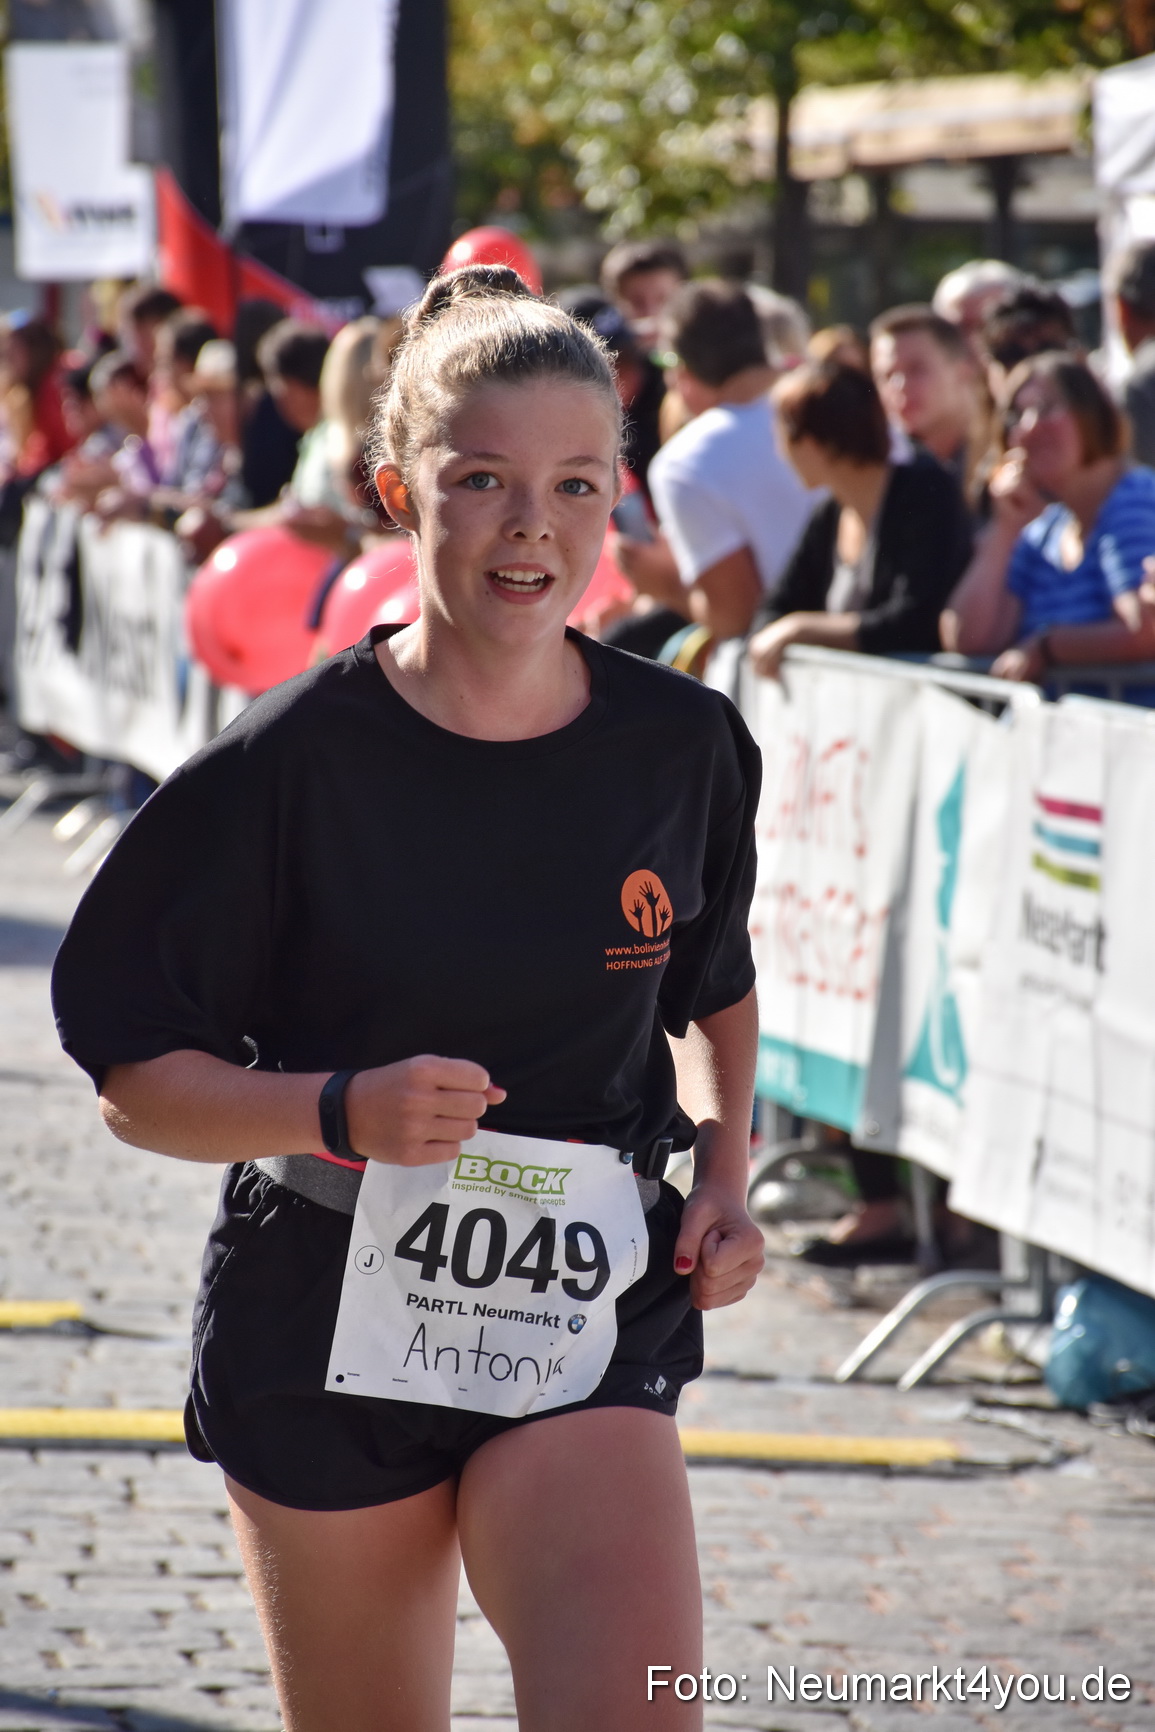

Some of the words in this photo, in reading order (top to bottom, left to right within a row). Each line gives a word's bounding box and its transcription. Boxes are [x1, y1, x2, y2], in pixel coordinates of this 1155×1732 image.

[606, 959, 653, 970] HOFFNUNG
[453, 1153, 573, 1195] BOCK
[451, 1181, 492, 1194] inspired
[494, 1186, 507, 1197] by
[508, 1192, 538, 1204] smart
[363, 1252, 375, 1268] J
[394, 1201, 611, 1302] 4049
[405, 1292, 468, 1316] PARTL
[472, 1303, 561, 1329] Neumarkt
